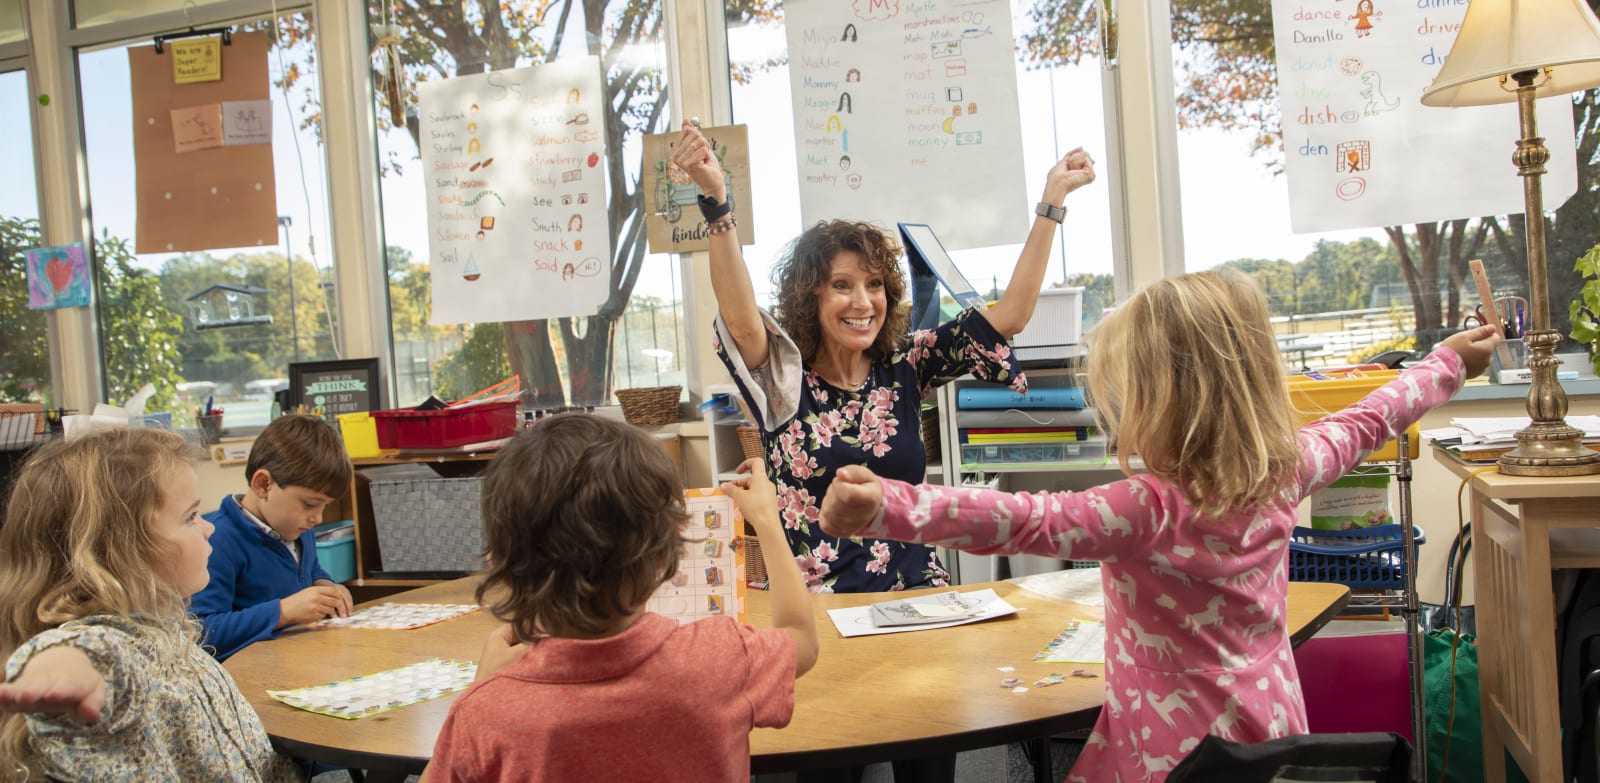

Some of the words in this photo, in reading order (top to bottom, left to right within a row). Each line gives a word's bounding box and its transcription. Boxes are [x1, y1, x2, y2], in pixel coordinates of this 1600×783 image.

[1417, 0, 1471, 8] dinne
[1293, 6, 1341, 21] dance
[1417, 16, 1462, 35] drive
[1293, 28, 1343, 44] Danillo
[903, 52, 928, 63] map
[1291, 54, 1334, 71] donut
[904, 64, 933, 80] mat
[803, 76, 840, 91] Mommy
[1295, 80, 1330, 99] dino
[1297, 104, 1337, 125] dish
[907, 122, 940, 132] moon
[908, 136, 949, 149] money
[1298, 137, 1328, 156] den
[528, 151, 583, 169] strawberry
[911, 157, 929, 167] me
[806, 172, 838, 188] monkey
[672, 222, 710, 243] kindn
[318, 381, 357, 392] THINK
